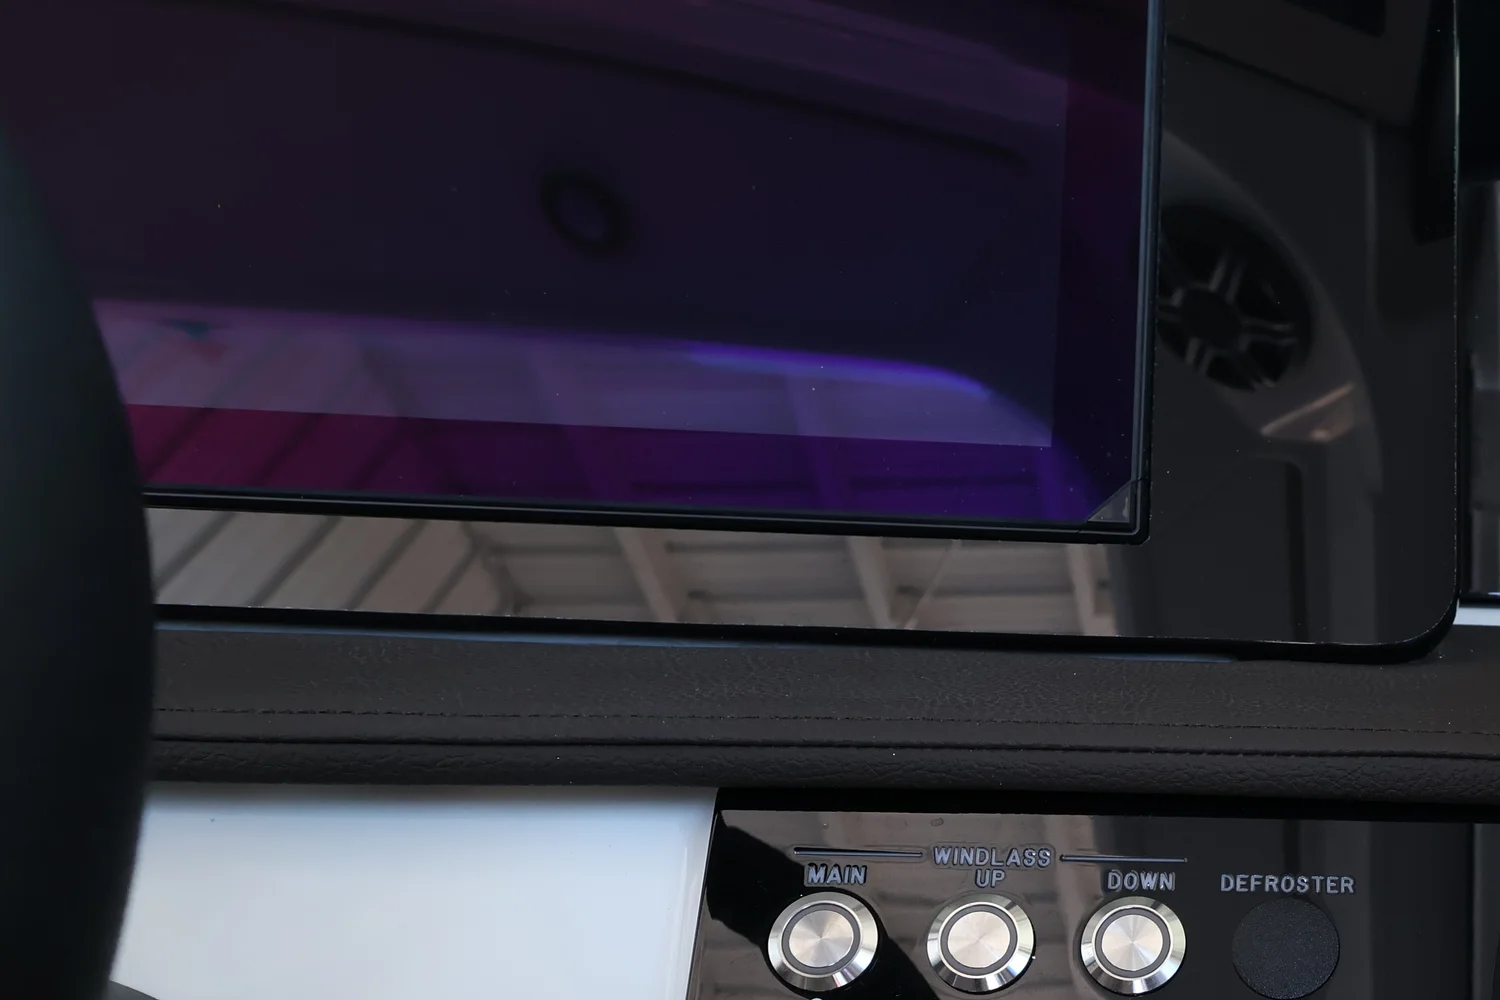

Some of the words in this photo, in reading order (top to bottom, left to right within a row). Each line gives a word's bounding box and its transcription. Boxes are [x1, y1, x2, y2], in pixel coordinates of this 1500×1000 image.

[932, 847, 1053, 868] WINDLASS
[806, 864, 867, 886] MAIN
[975, 869, 1006, 888] UP
[1108, 870, 1176, 891] DOWN
[1220, 873, 1355, 895] DEFROSTER
